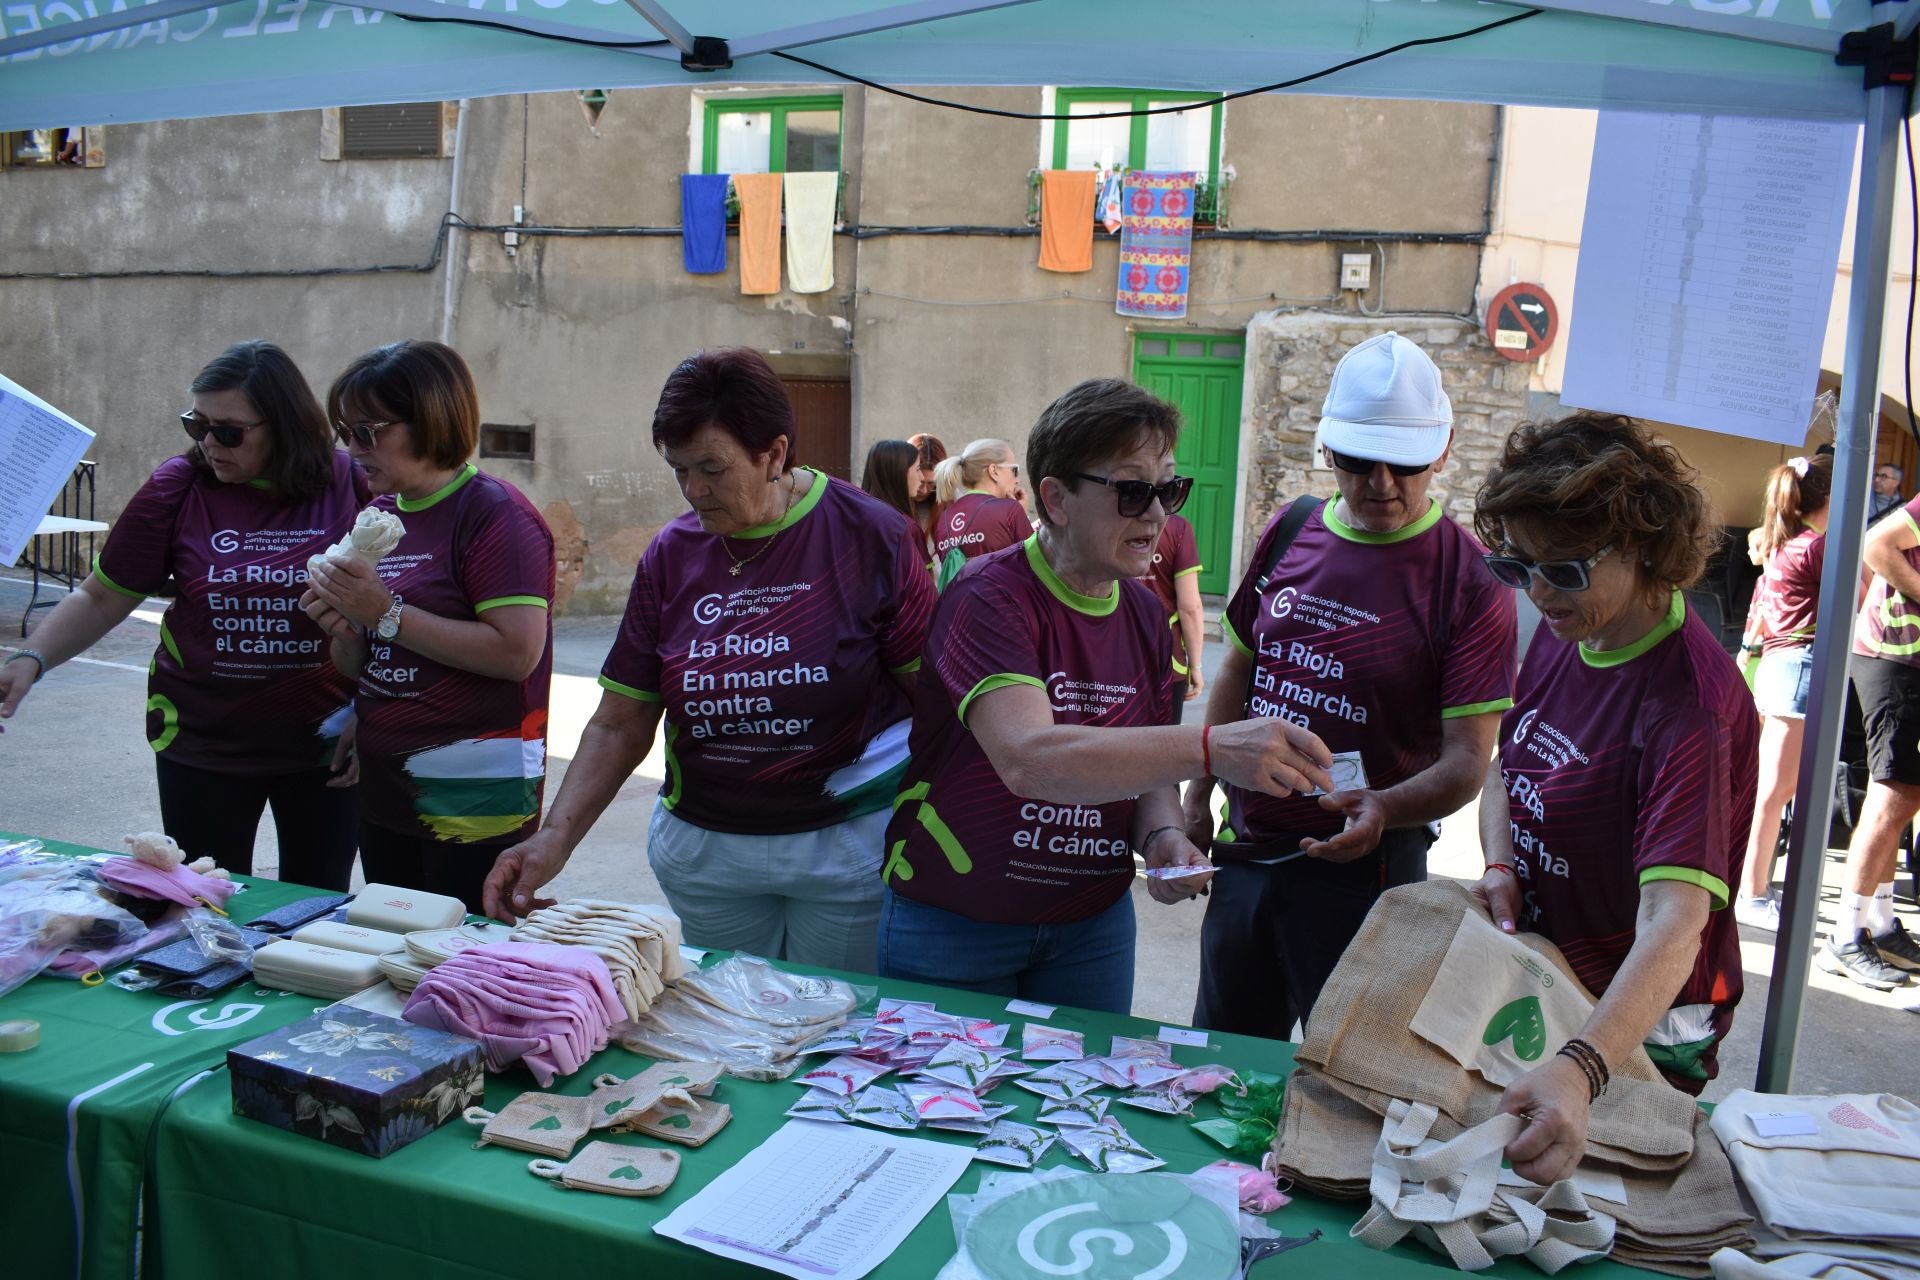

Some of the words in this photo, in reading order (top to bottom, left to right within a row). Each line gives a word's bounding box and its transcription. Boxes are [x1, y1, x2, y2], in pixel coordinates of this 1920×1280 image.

[289, 529, 325, 537] española
[938, 532, 985, 551] CORNAGO
[268, 544, 289, 553] Rioja
[207, 565, 237, 583] La
[246, 564, 310, 587] Rioja
[771, 582, 811, 594] española
[207, 593, 239, 611] En
[724, 608, 735, 617] en
[736, 608, 747, 616] La
[747, 605, 769, 615] Rioja
[726, 598, 753, 608] contra
[1301, 594, 1342, 609] asociación
[1344, 605, 1380, 624] española
[1293, 613, 1304, 621] en
[1305, 615, 1316, 625] La
[1317, 618, 1337, 632] Rioja
[1297, 602, 1323, 616] contra
[1333, 614, 1360, 627] cáncer
[212, 617, 290, 633] contra
[216, 635, 233, 652] el
[239, 637, 322, 654] cáncer
[688, 639, 717, 659] La
[724, 631, 790, 658] Rioja
[1258, 632, 1282, 659] La
[1287, 641, 1344, 680] Rioja
[683, 669, 715, 692] En
[723, 662, 829, 690] marcha
[1090, 693, 1099, 702] el
[1100, 694, 1126, 704] cáncer
[1254, 665, 1275, 692] En
[1279, 680, 1368, 725] marcha
[684, 693, 772, 717] contra
[1083, 703, 1107, 716] Rioja
[1251, 695, 1310, 729] contra
[692, 719, 717, 739] el
[721, 717, 813, 736] cáncer
[1527, 743, 1538, 753] en
[1537, 747, 1548, 760] La
[1020, 802, 1102, 828] contra
[1012, 826, 1042, 850] el
